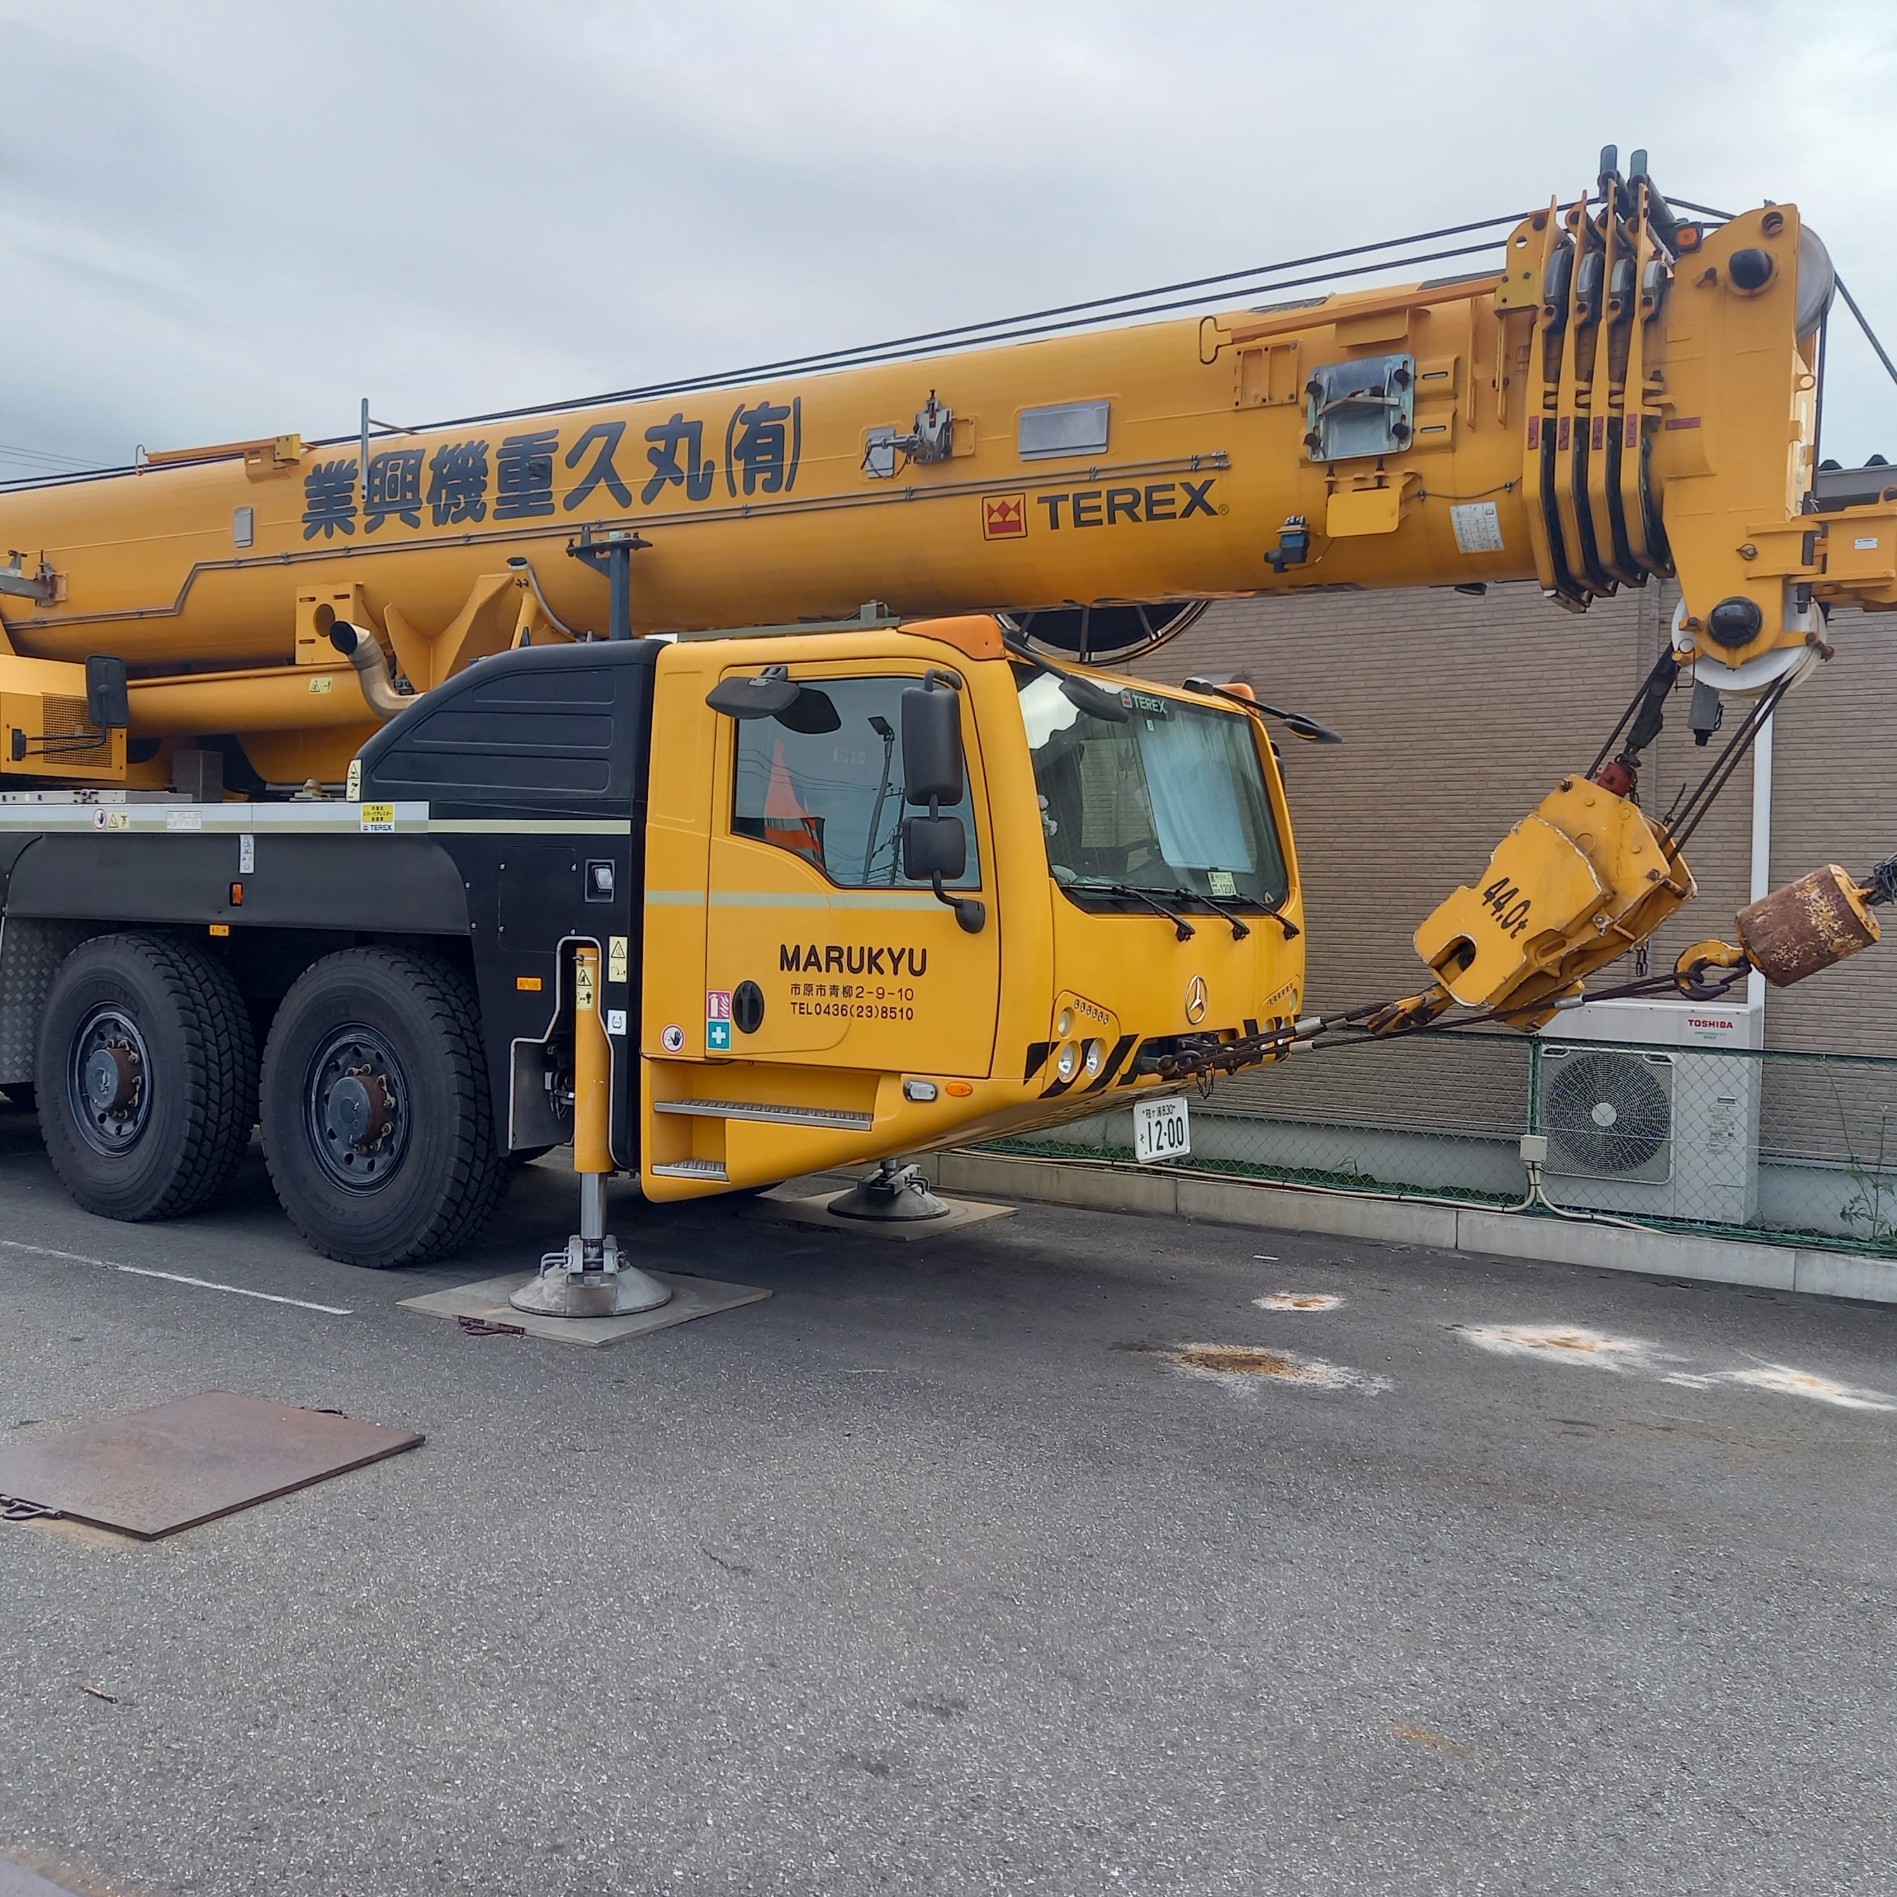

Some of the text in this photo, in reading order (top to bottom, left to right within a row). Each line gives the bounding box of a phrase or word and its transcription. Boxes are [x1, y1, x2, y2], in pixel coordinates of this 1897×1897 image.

[1037, 479, 1219, 530] TEREX
[1132, 694, 1167, 714] TEREX
[780, 944, 927, 977] MARUKYU
[1687, 1019, 1733, 1029] TOSHIBA
